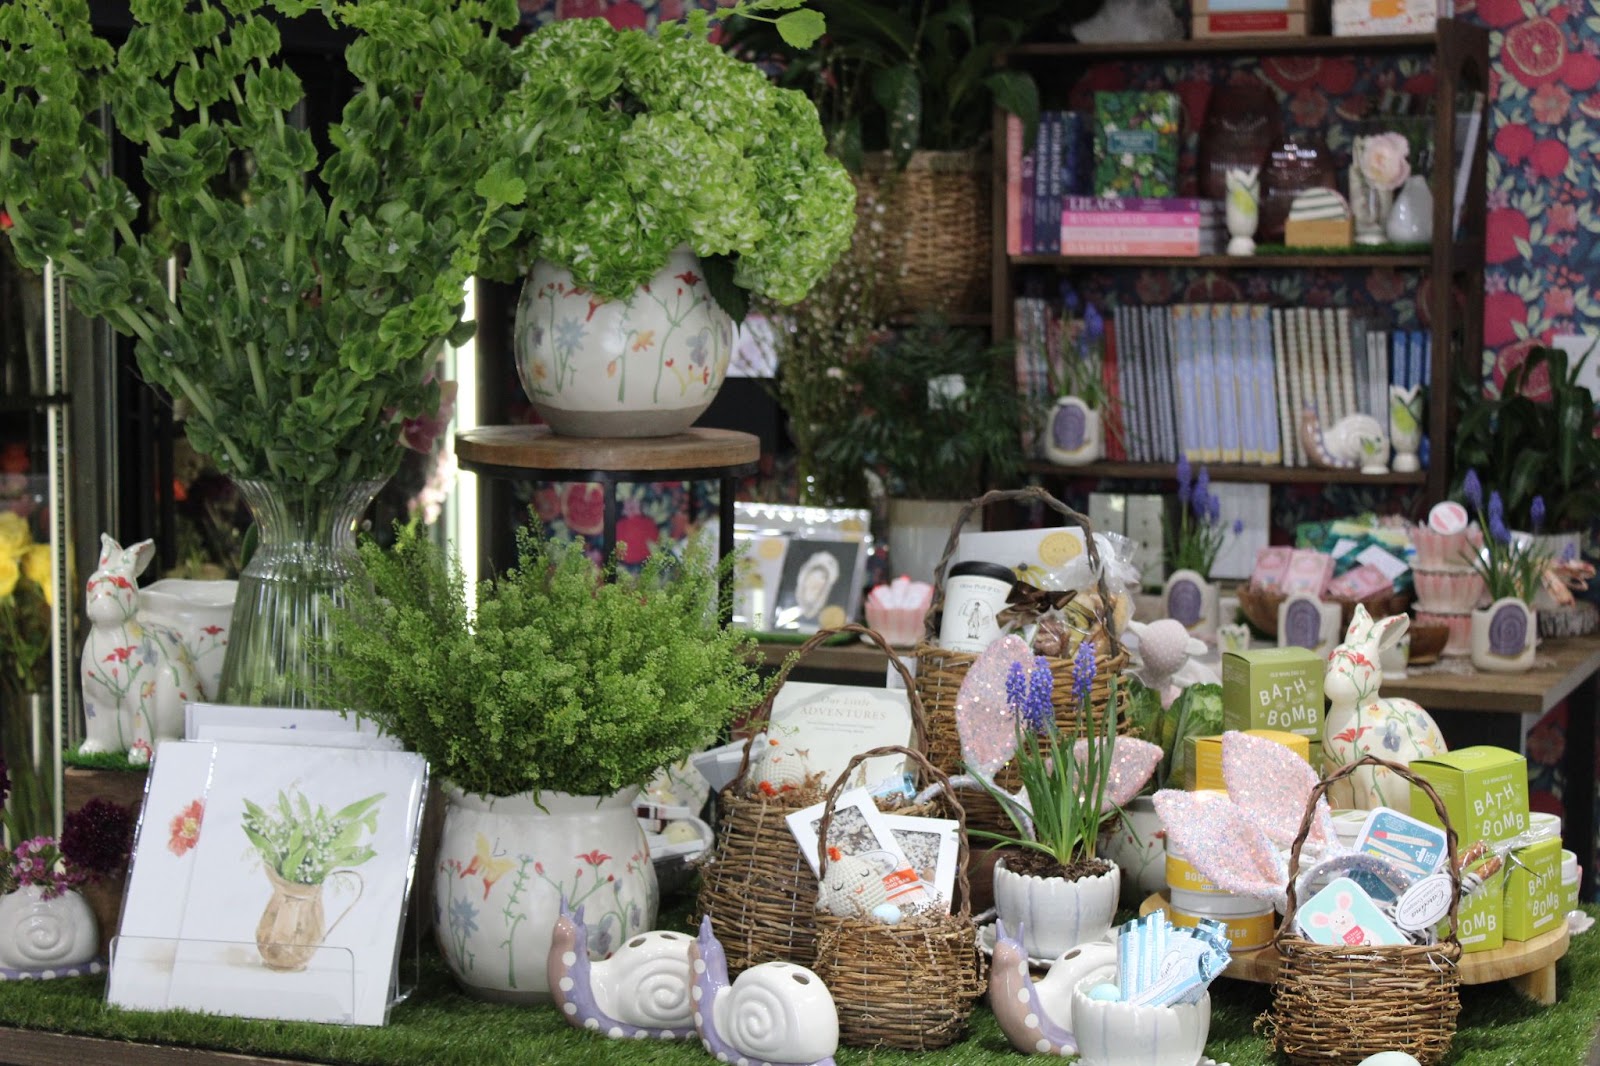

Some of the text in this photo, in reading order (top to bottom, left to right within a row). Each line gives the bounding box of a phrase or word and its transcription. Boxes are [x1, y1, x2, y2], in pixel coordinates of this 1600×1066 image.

[1259, 677, 1307, 706] BATH
[799, 706, 887, 721] ADVENTURES
[1267, 704, 1317, 727] BOMB
[1473, 783, 1515, 816] BATH
[1482, 811, 1524, 837] BOMB
[1184, 870, 1205, 882] BOD
[1528, 863, 1555, 896] BATH
[1533, 891, 1560, 917] BOMB
[1229, 929, 1247, 938] TER
[1457, 911, 1496, 936] OMB
